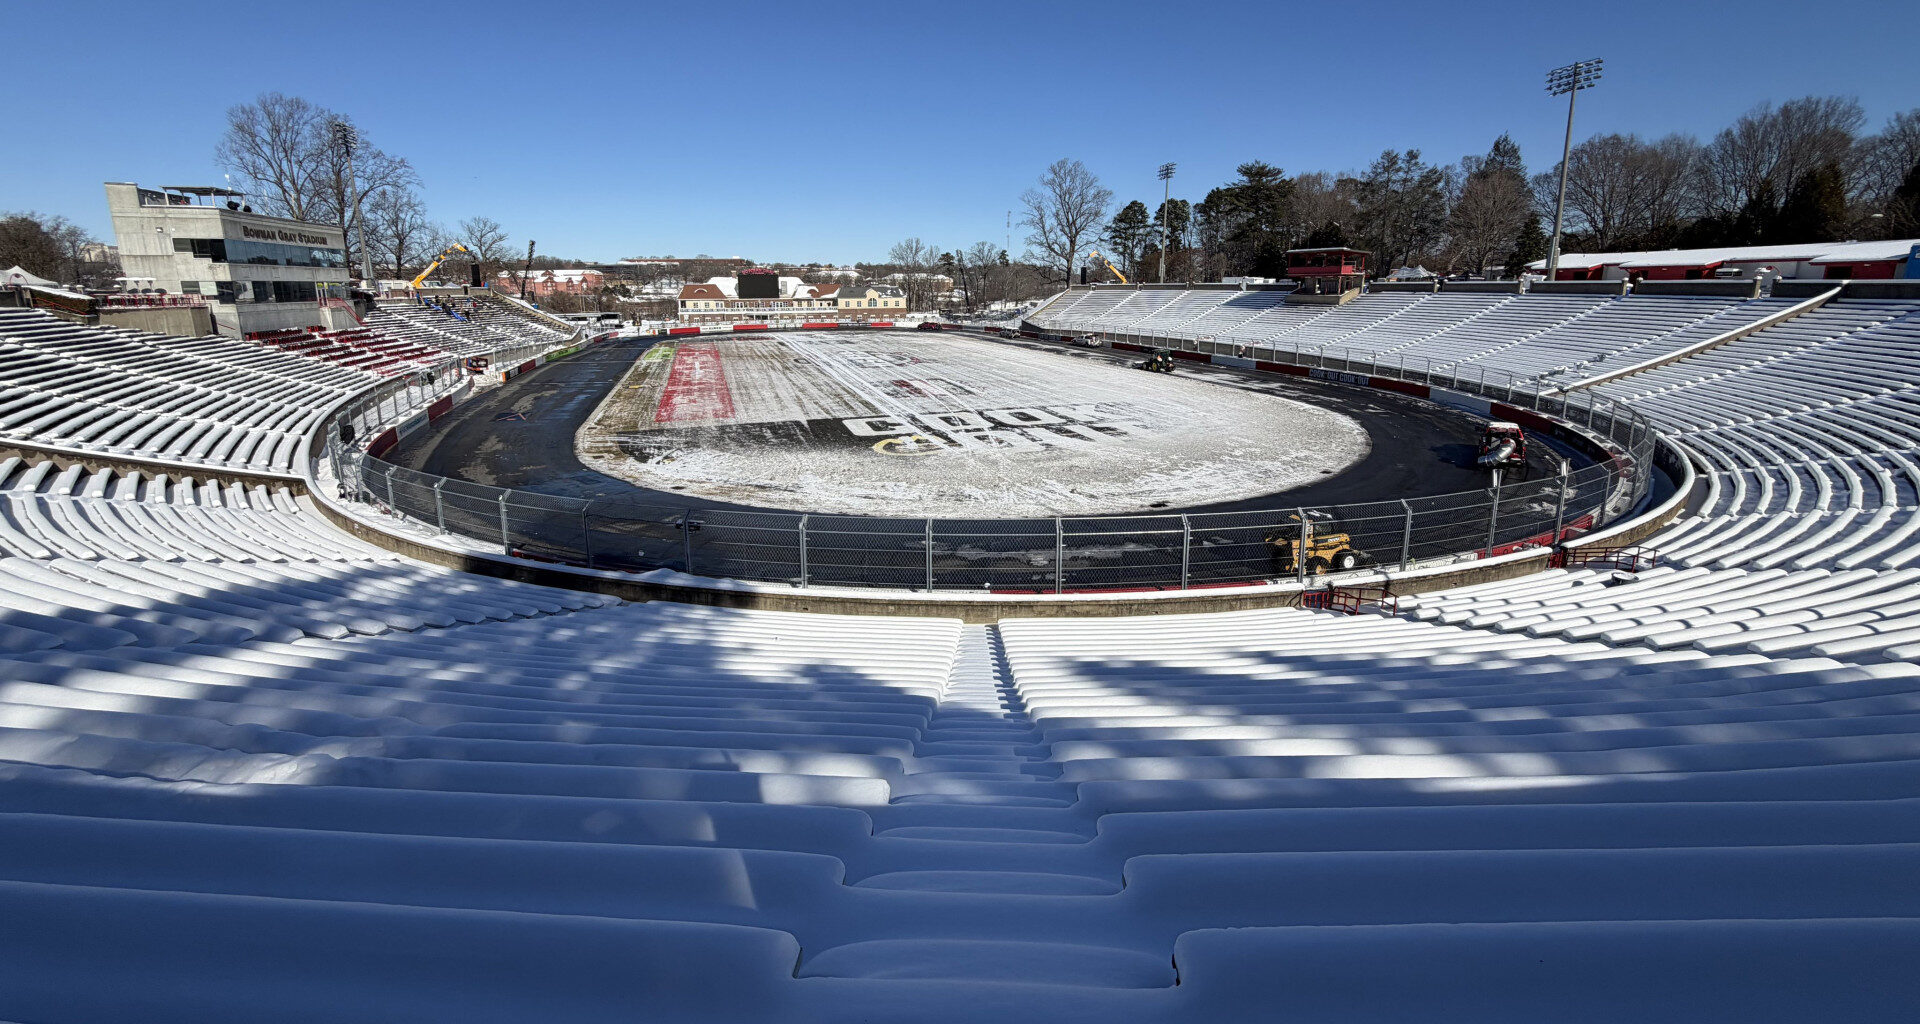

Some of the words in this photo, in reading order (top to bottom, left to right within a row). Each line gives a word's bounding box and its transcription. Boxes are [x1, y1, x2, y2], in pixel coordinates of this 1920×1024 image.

[242, 226, 277, 241] BOWMAN
[277, 230, 297, 242] GRAY
[297, 233, 326, 245] STADIUM
[1339, 373, 1356, 382] COOK
